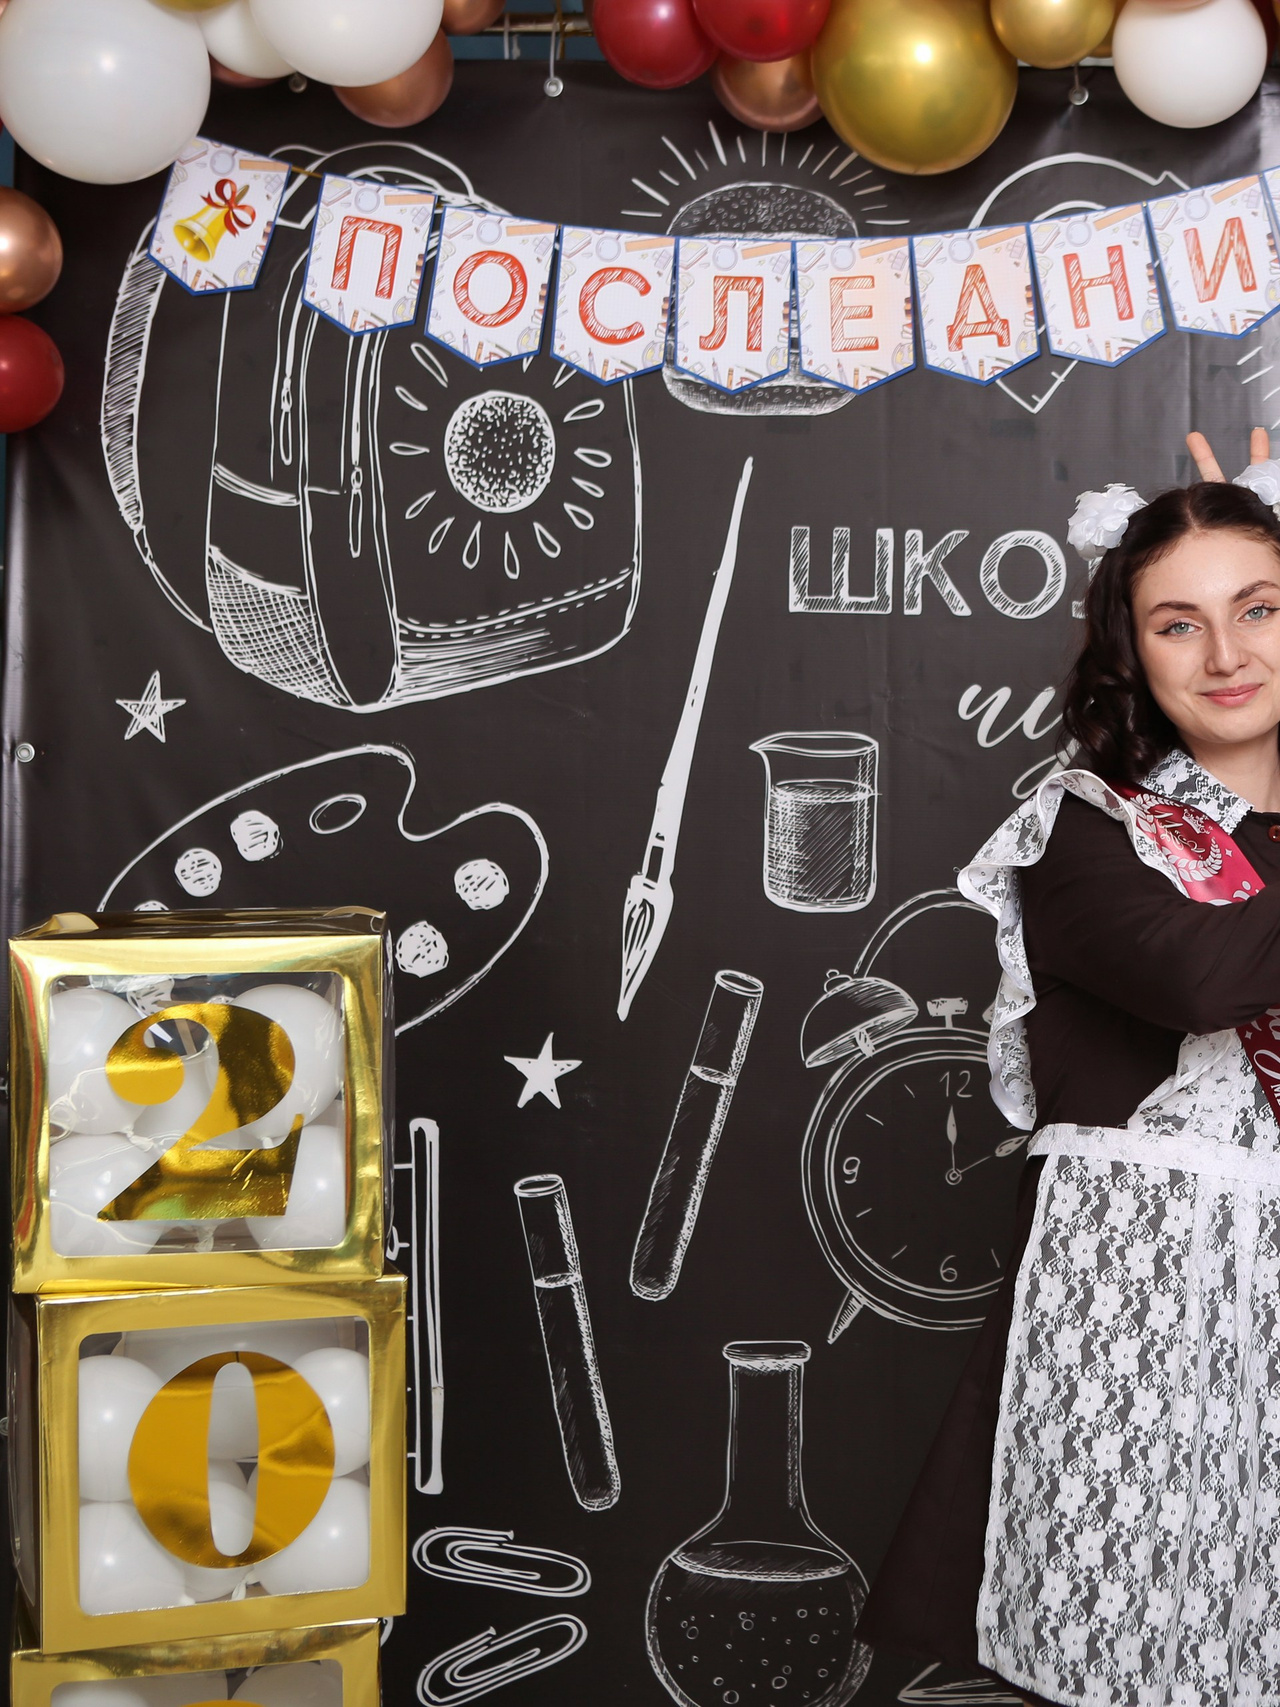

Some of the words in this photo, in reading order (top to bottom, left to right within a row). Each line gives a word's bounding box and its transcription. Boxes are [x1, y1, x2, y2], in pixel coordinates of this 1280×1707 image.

[939, 1070, 973, 1099] 12
[96, 1003, 303, 1221] 2
[842, 1155, 861, 1184] 9
[939, 1255, 958, 1283] 6
[127, 1351, 336, 1569] 0
